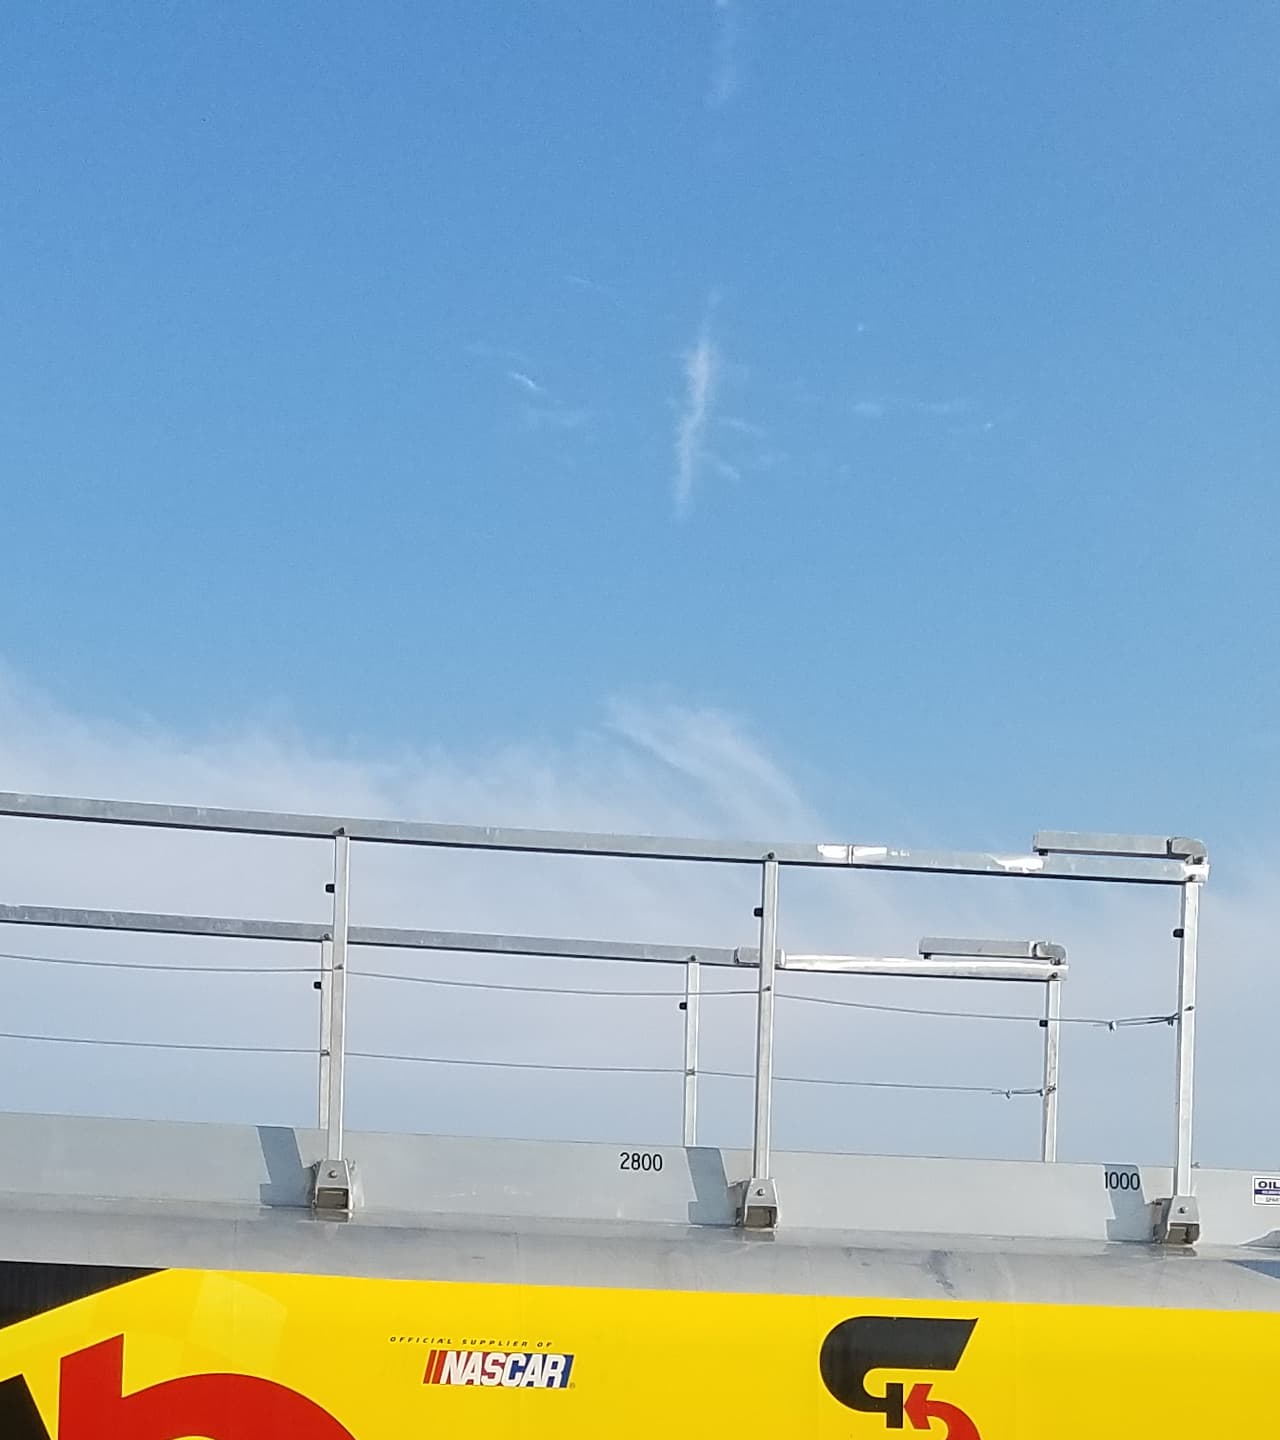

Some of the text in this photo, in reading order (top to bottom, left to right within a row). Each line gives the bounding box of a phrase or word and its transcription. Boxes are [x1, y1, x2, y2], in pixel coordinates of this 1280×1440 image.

[619, 1152, 663, 1172] 2800
[1104, 1171, 1141, 1191] 1000
[389, 1336, 453, 1345] OFFICIAL
[461, 1339, 528, 1348] SUPPLIER
[439, 1350, 566, 1388] NASCAR
